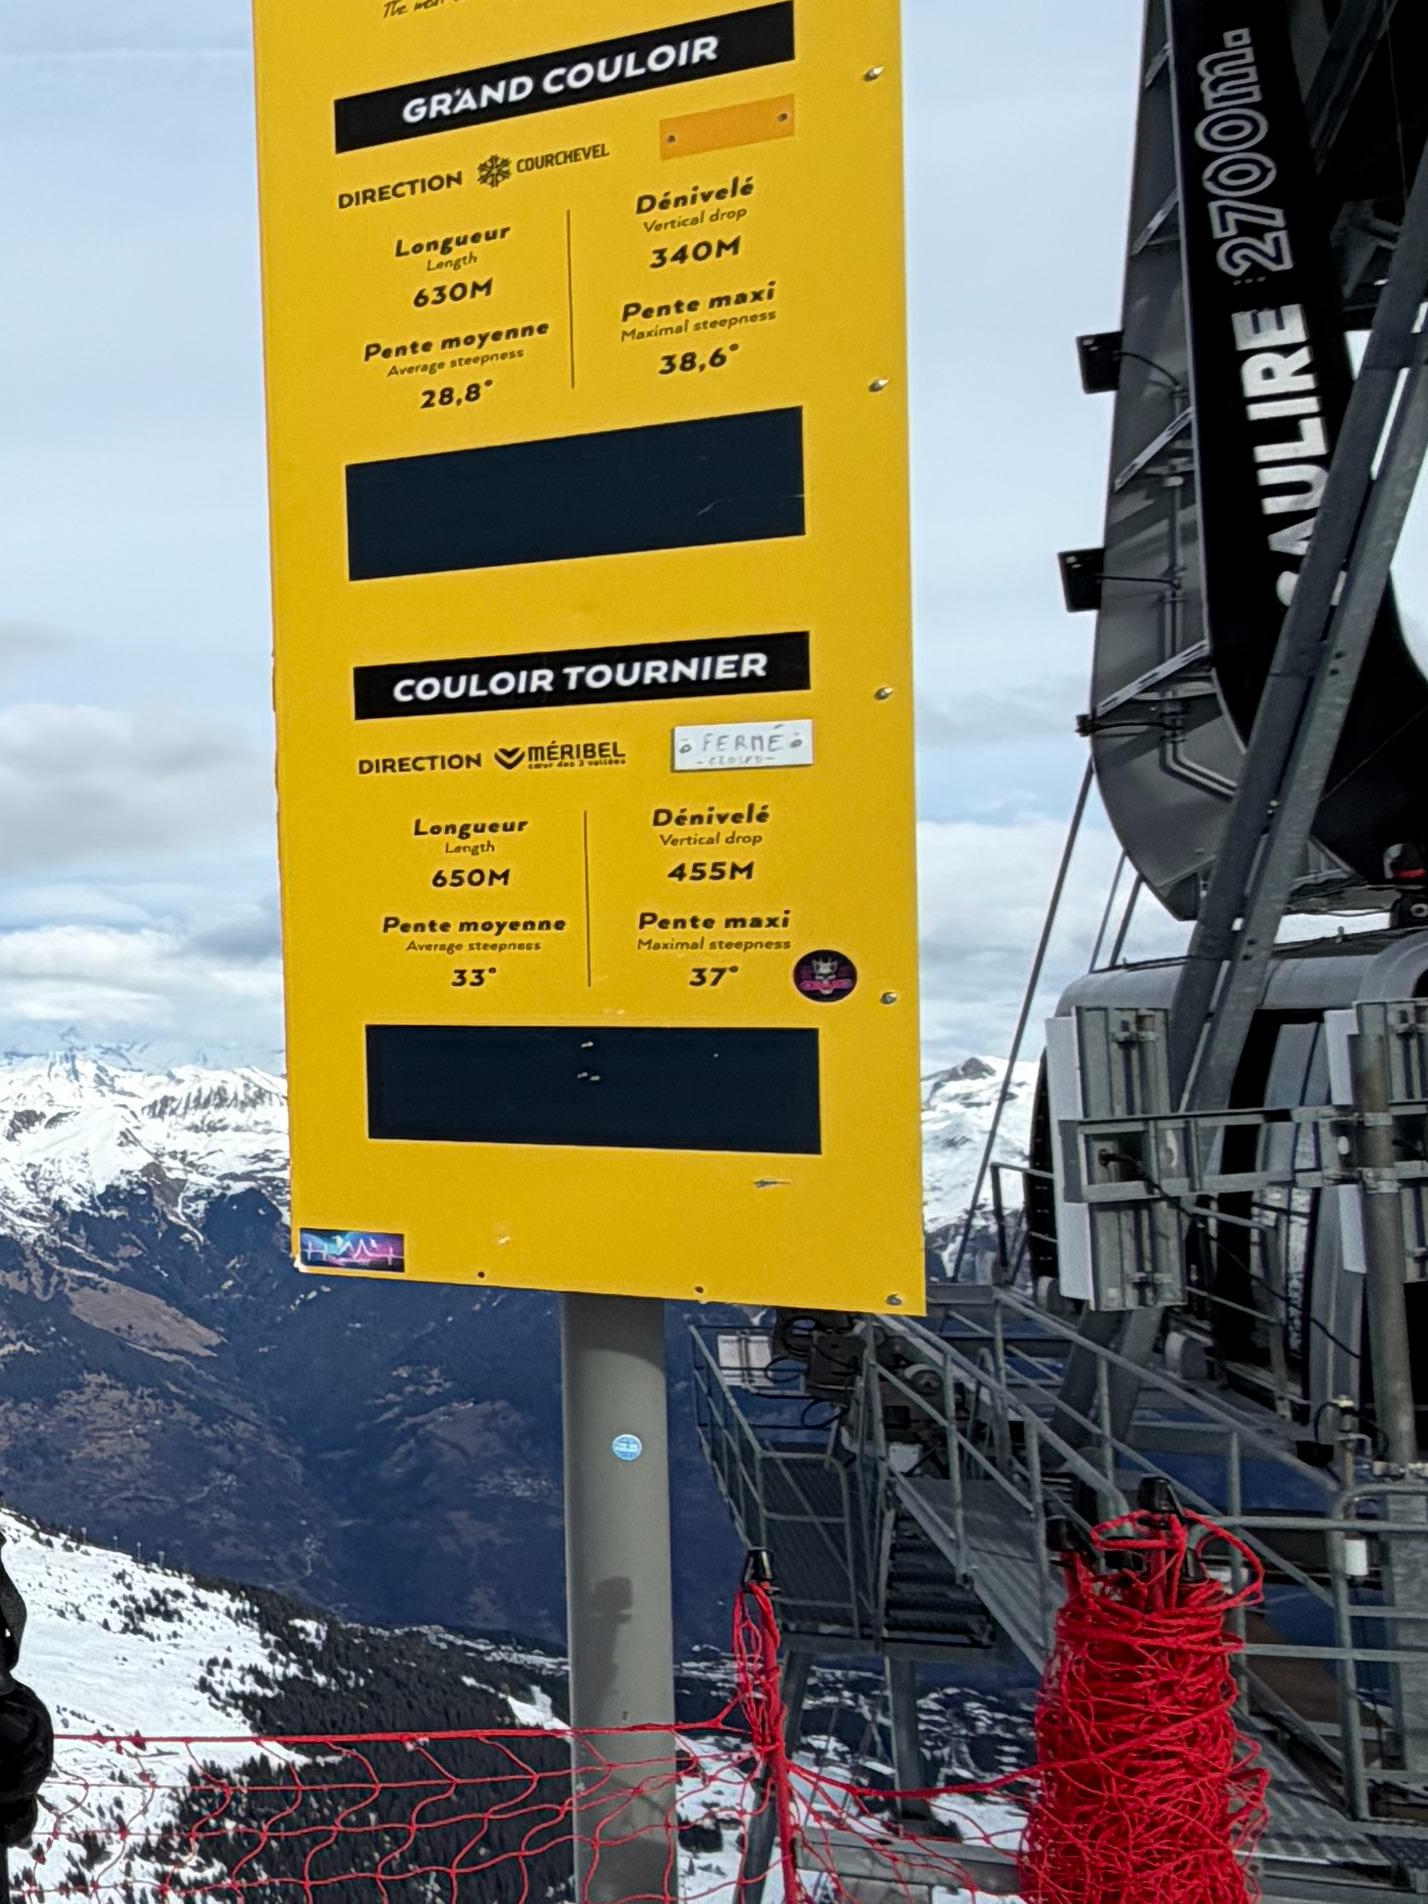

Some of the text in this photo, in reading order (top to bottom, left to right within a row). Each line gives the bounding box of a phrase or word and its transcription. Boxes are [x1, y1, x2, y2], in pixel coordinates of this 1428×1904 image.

[382, 0, 408, 18] The
[402, 35, 720, 124] GRAND COULOIR
[338, 143, 610, 209] DIRECTION COURCHEVEL
[635, 175, 754, 214] Dénivelé
[643, 207, 748, 232] Vertical drop
[395, 226, 510, 257] Longueur
[649, 235, 741, 269] 340M
[427, 251, 478, 272] Length
[413, 277, 493, 308] 630M
[621, 280, 776, 323] Pente maxi
[621, 310, 777, 342] Maximal steepness
[364, 322, 549, 362] Pente moyenne
[387, 349, 524, 377] Average steepness
[658, 343, 740, 376] 38,6°
[420, 379, 493, 409] 28,8°
[393, 652, 768, 703] COULOIR TOURNIER
[358, 740, 626, 775] DIRECTION MÉRIBEL
[652, 802, 770, 827] Dénivelé
[413, 818, 528, 840] Longueur
[659, 831, 763, 846] Vertical drop
[445, 840, 495, 856] Length
[432, 869, 510, 888] 650M
[667, 861, 755, 882] 455M
[383, 916, 566, 937] Pente moyenne
[639, 909, 792, 930] Pente maxi
[406, 940, 542, 955] Average steepness
[637, 937, 791, 953] Maximal steepness
[451, 967, 497, 987] 33°
[689, 965, 739, 987] 37°
